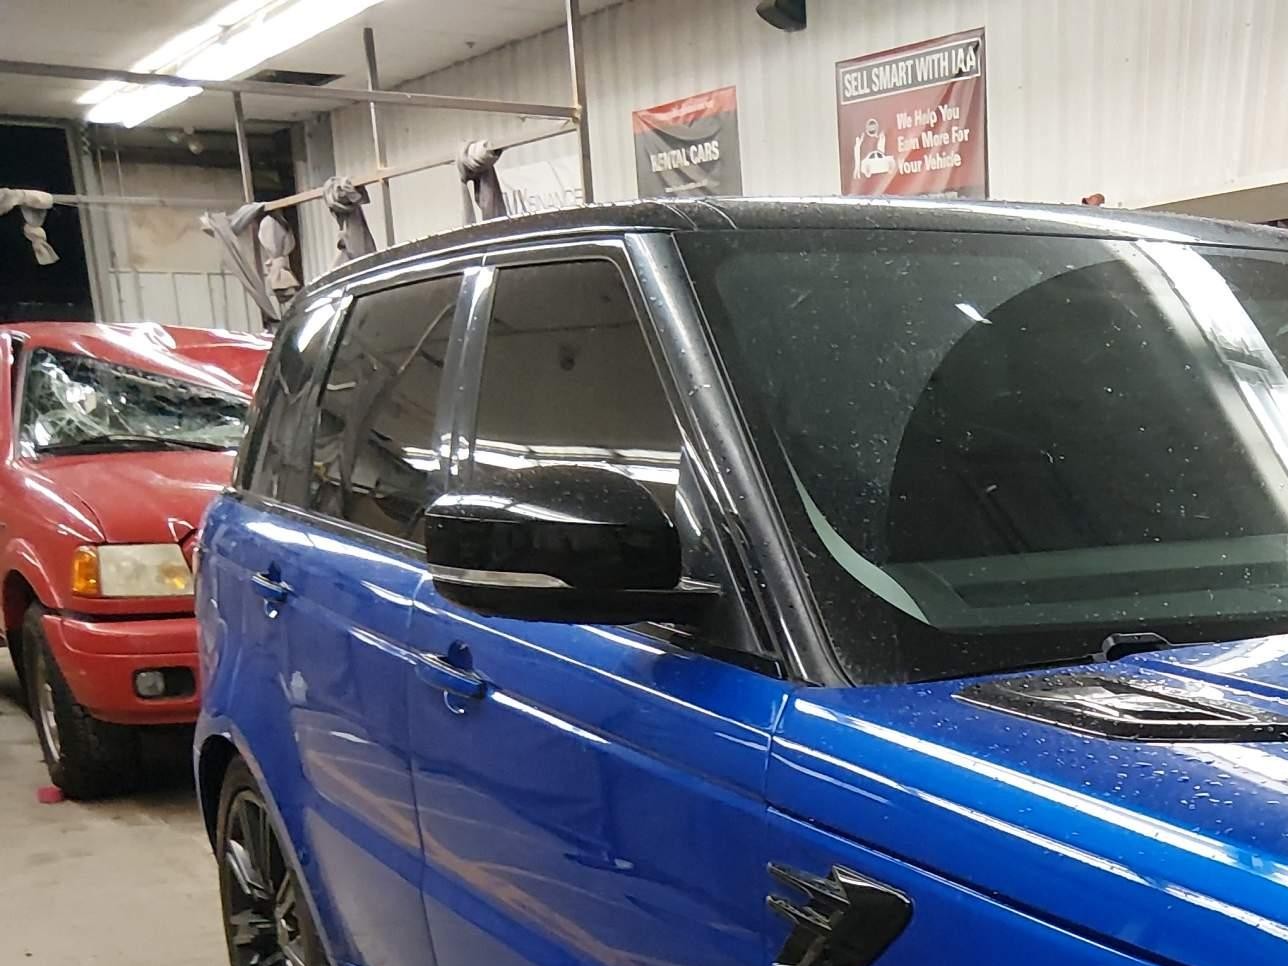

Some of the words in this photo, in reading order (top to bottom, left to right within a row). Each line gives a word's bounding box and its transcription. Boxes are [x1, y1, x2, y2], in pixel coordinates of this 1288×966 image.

[844, 70, 870, 98] SELL
[871, 60, 914, 92] SMART
[915, 51, 949, 82] WITH
[951, 45, 976, 75] IAA
[896, 112, 912, 130] We
[914, 107, 938, 128] Help
[938, 103, 960, 122] You
[921, 130, 949, 149] More
[951, 126, 970, 143] For
[690, 140, 720, 165] CARS
[897, 158, 922, 175] Your
[924, 151, 961, 171] Vehicle
